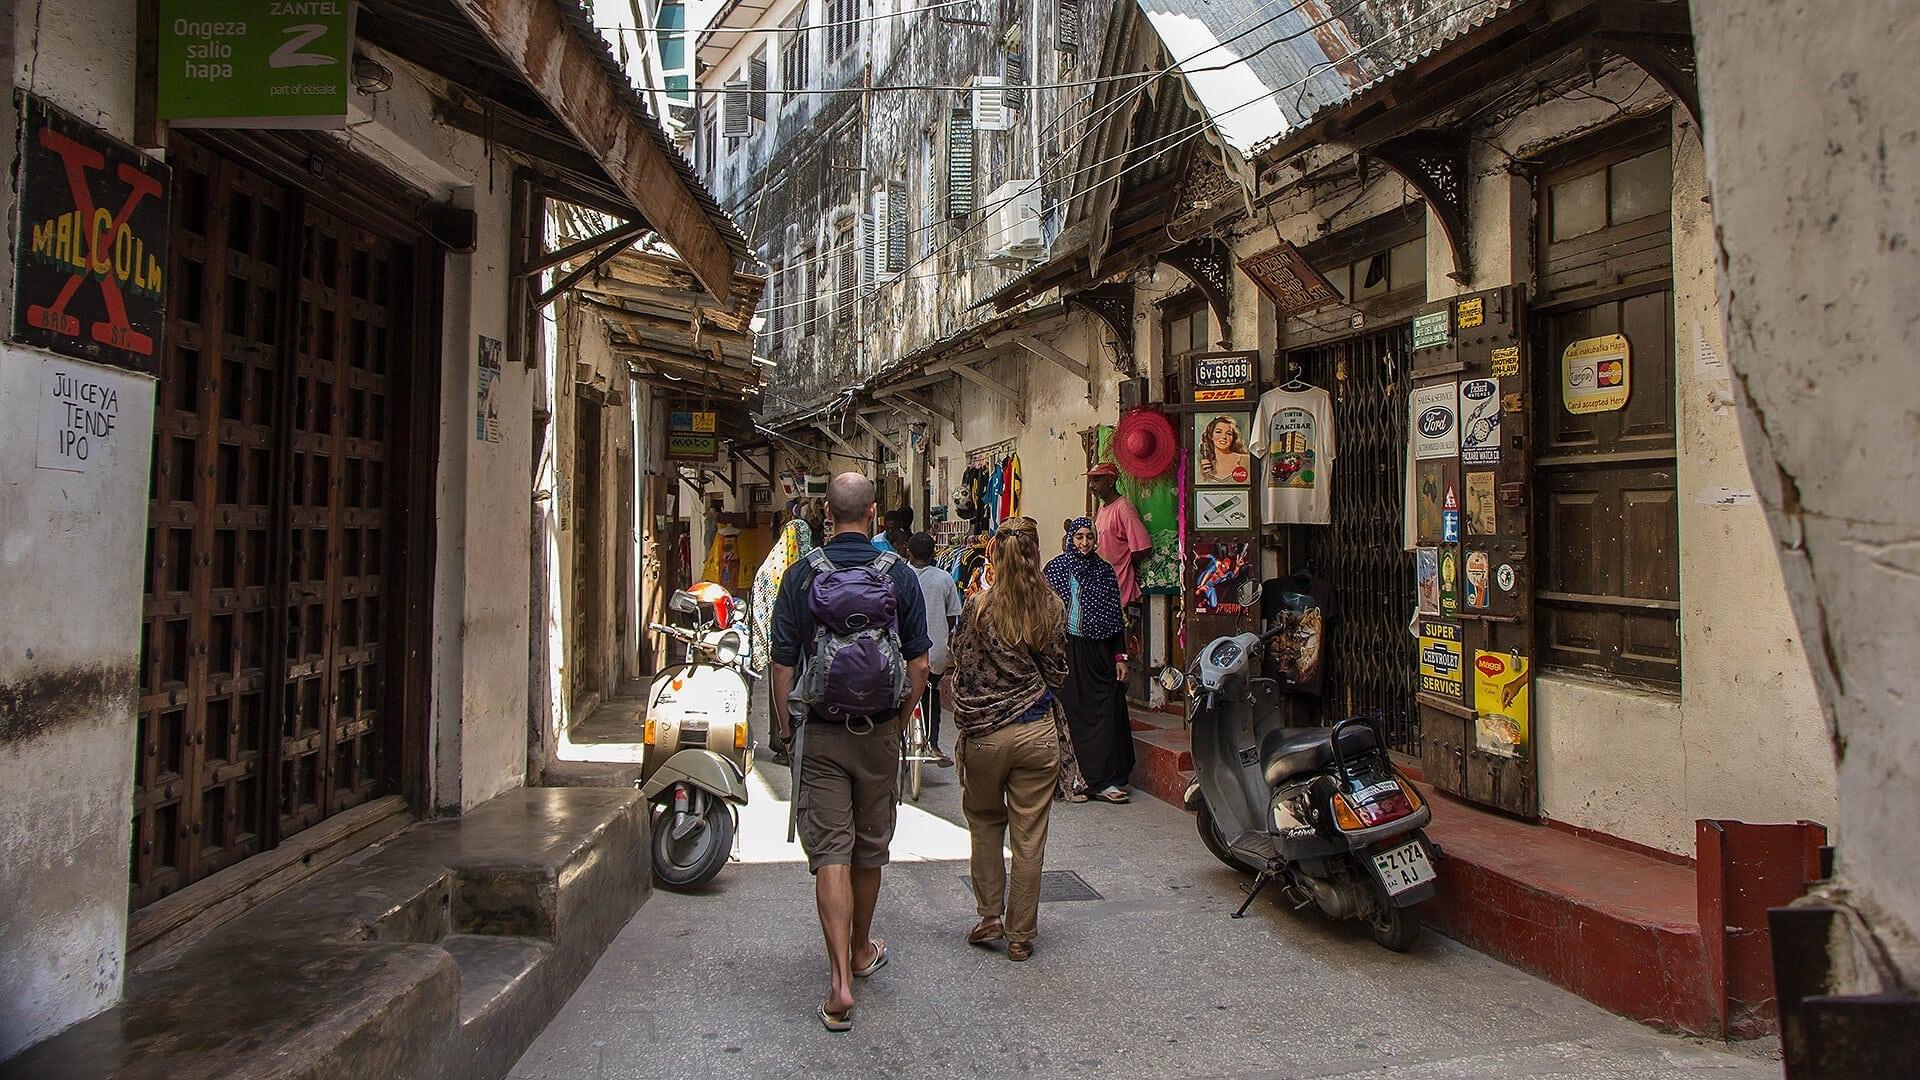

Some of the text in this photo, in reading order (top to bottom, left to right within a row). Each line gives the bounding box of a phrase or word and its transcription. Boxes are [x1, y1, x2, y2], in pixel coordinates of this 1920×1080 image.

[270, 2, 342, 15] ZANTEL
[173, 19, 247, 40] Ongeza
[186, 41, 232, 58] salio
[185, 60, 233, 81] hapa
[270, 84, 337, 96] part of etisalat
[27, 126, 163, 356] X
[32, 207, 162, 294] MALCOLM
[1251, 253, 1293, 277] ZANZIBAR
[1267, 267, 1295, 285] CURIO
[1280, 279, 1304, 295] SHOP
[1202, 391, 1236, 400] DHL
[1568, 396, 1625, 410] Card accepted Here
[1423, 411, 1447, 433] Ford
[60, 429, 89, 460] IPO
[1425, 623, 1454, 640] SUPER
[1423, 650, 1458, 668] CHEVROLET
[1423, 676, 1461, 696] SERVICE
[1400, 866, 1419, 885] AJ
